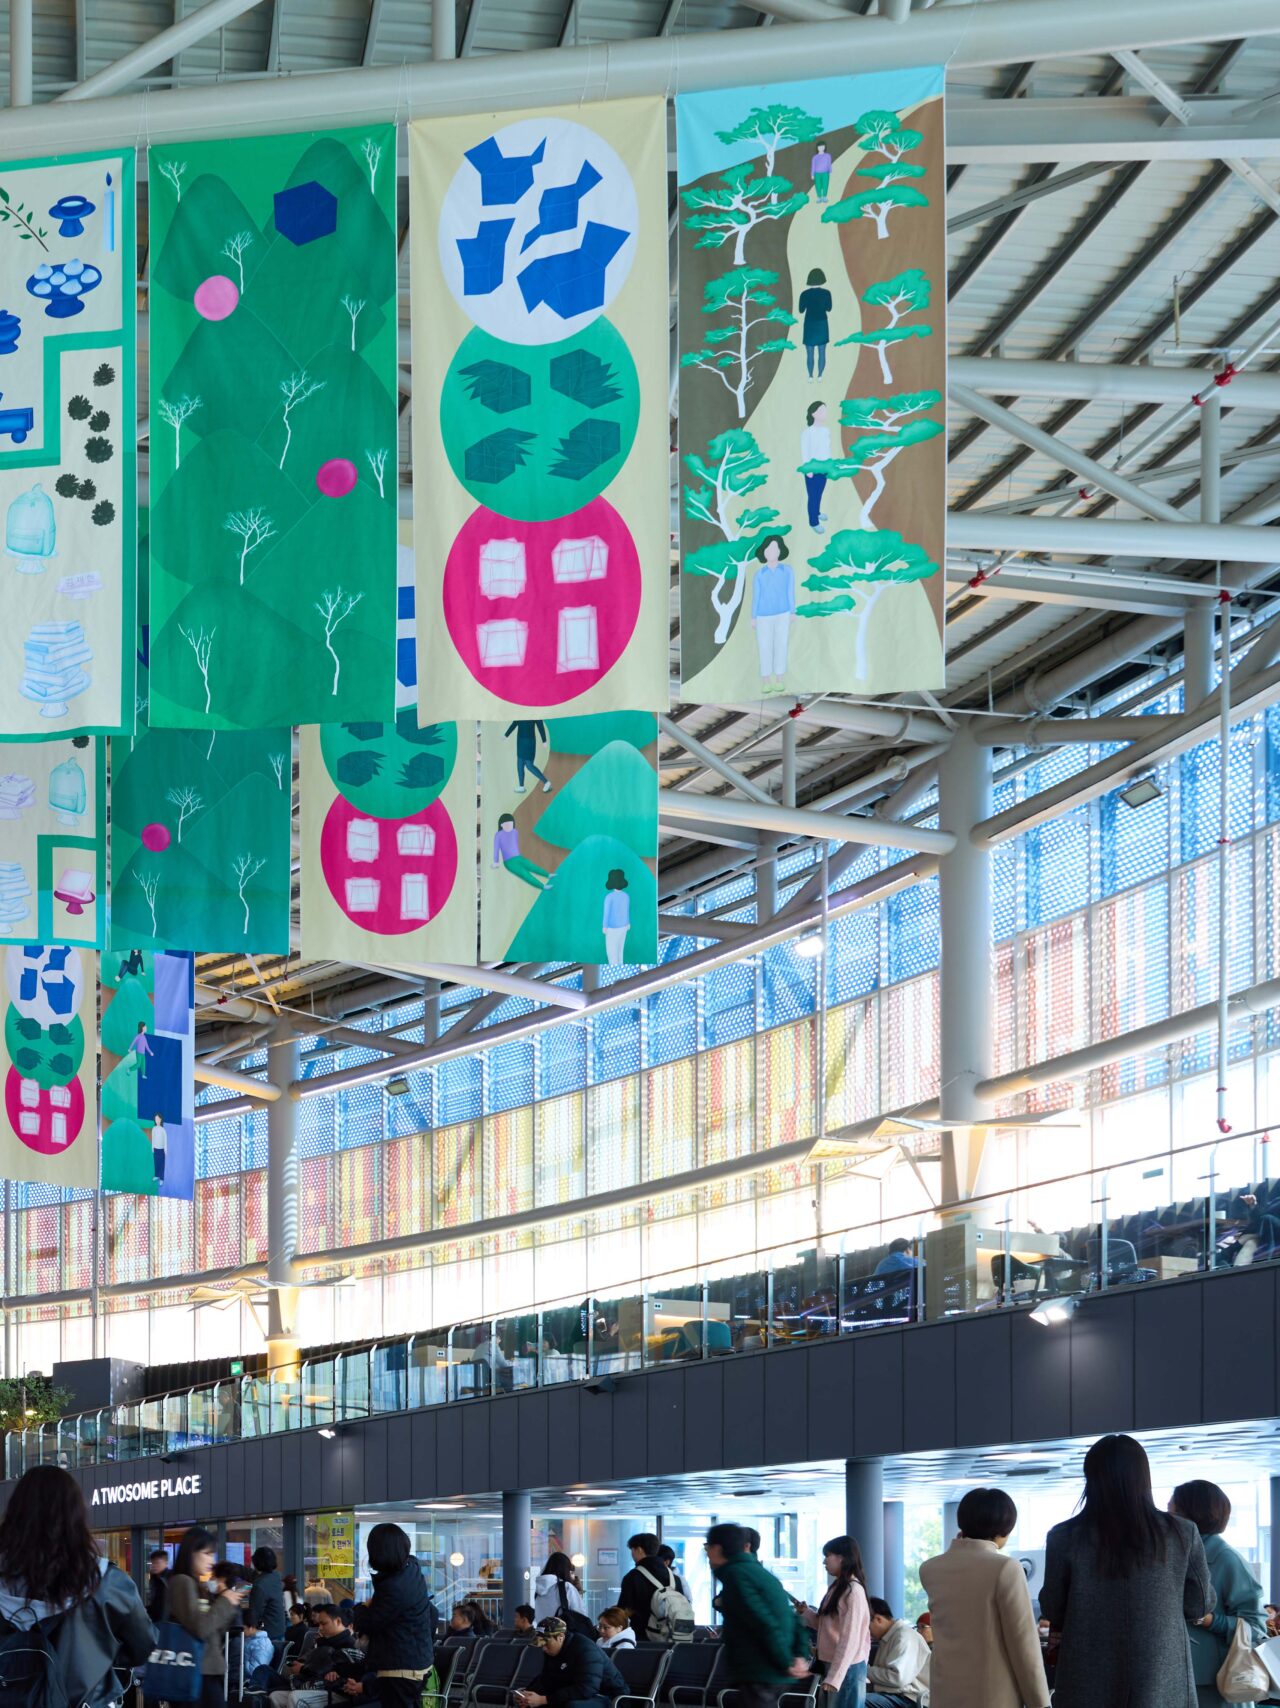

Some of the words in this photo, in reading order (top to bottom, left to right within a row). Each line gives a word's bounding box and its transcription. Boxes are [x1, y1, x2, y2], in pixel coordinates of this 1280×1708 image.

[91, 1489, 100, 1506] A
[100, 1480, 159, 1505] TWOSOME
[160, 1474, 201, 1498] PLACE
